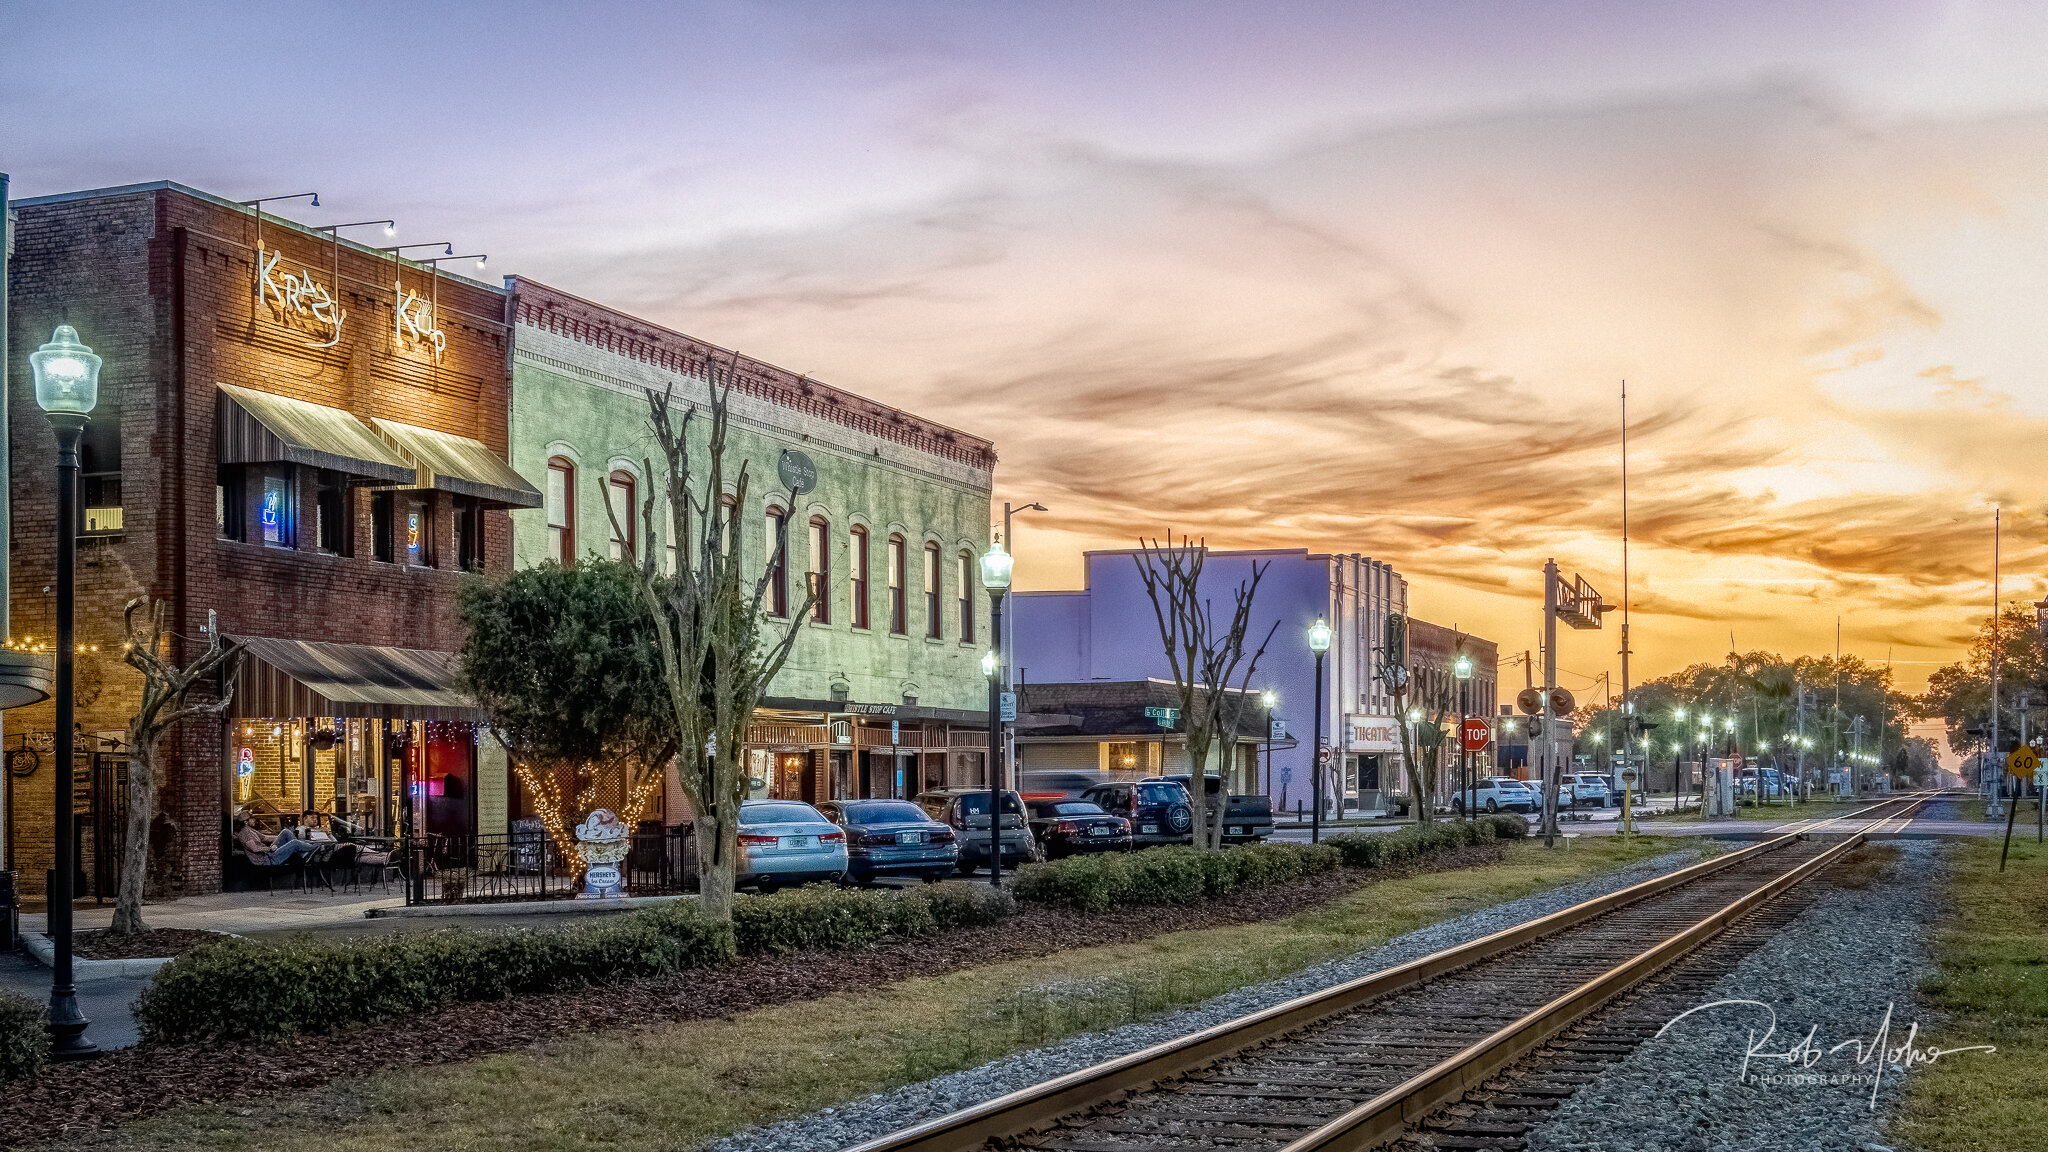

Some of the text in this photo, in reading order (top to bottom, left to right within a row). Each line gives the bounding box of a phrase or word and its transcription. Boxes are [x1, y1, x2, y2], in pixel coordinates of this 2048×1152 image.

[868, 705, 883, 714] STOP
[1152, 709, 1175, 717] Colls
[1354, 726, 1393, 741] THEATRE
[1466, 728, 1488, 741] TOP
[2014, 756, 2033, 769] 60
